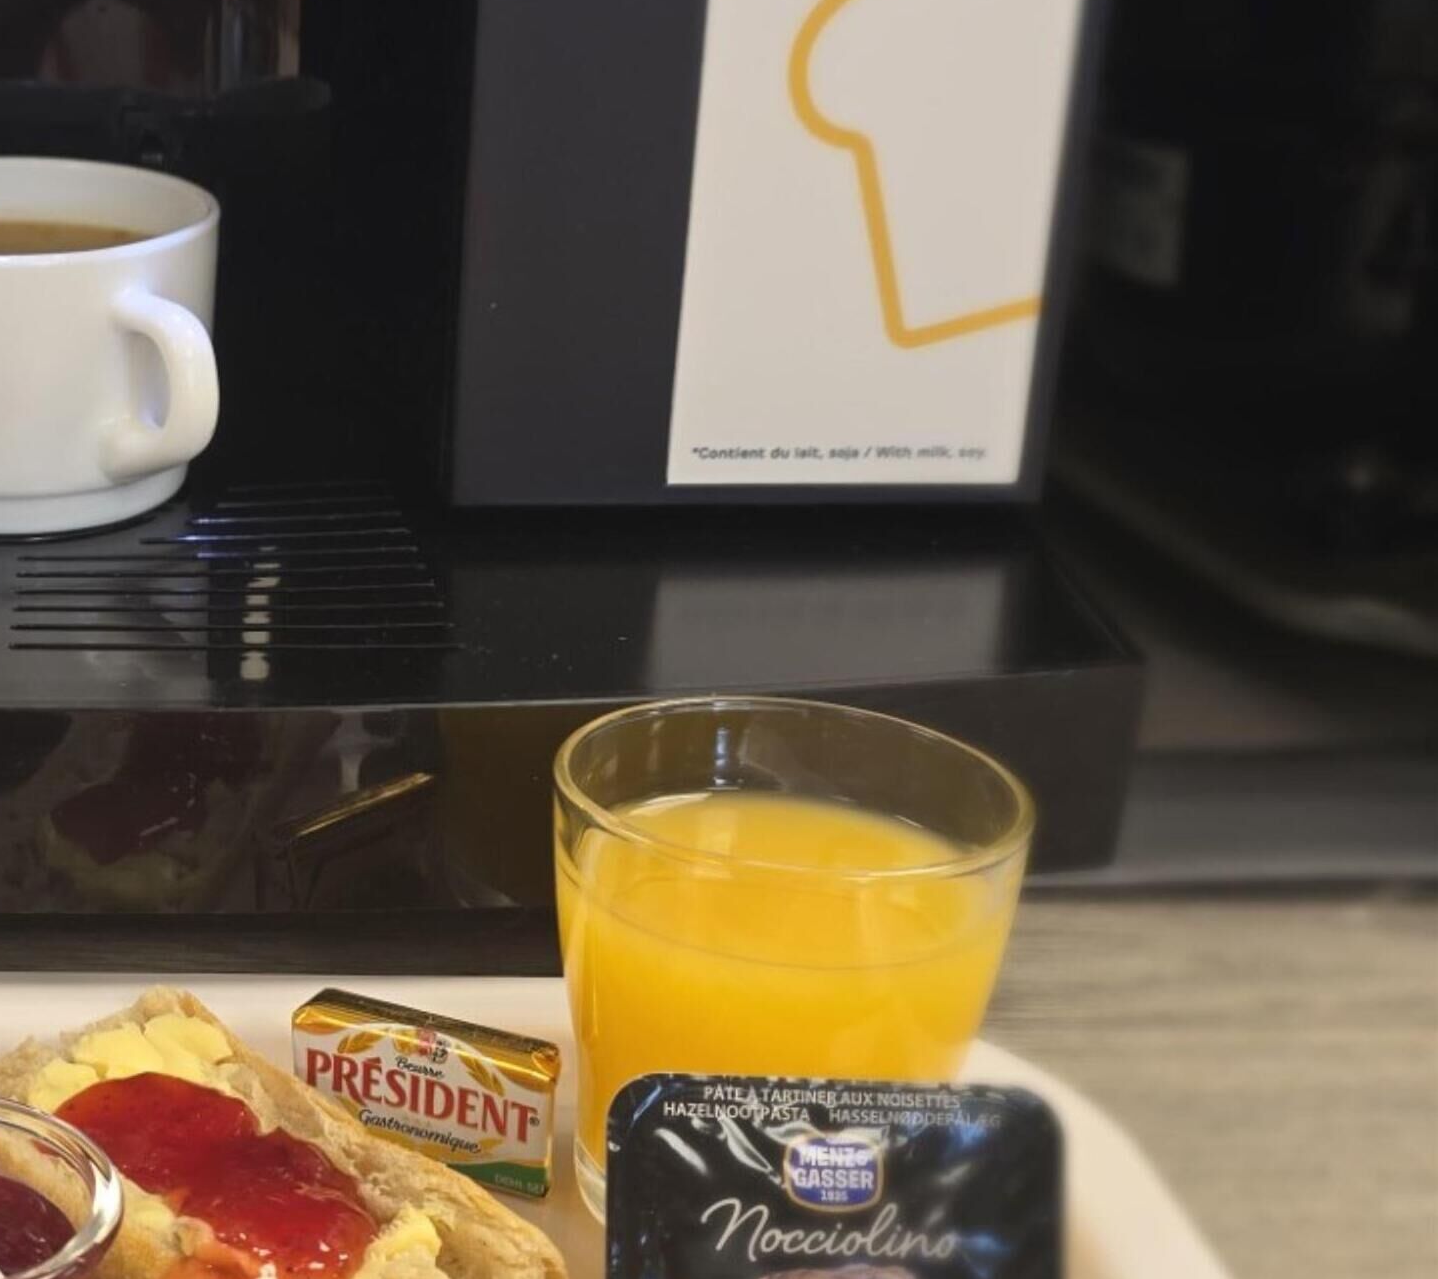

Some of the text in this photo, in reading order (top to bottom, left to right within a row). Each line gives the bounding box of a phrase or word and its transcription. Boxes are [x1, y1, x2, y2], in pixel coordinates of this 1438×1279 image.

[770, 446, 790, 459] du
[828, 446, 859, 462] soja
[876, 446, 912, 459] With
[306, 1048, 537, 1144] PRÉSIDENT
[760, 1087, 836, 1106] TARTINER
[844, 1092, 874, 1106] AUX
[876, 1092, 961, 1109] NOISETTES
[663, 1101, 811, 1122] HAZELNOOTPASTA
[358, 1108, 482, 1155] Gastronomique
[793, 1167, 875, 1191] GASSER
[700, 1197, 959, 1263] Nocciolino
